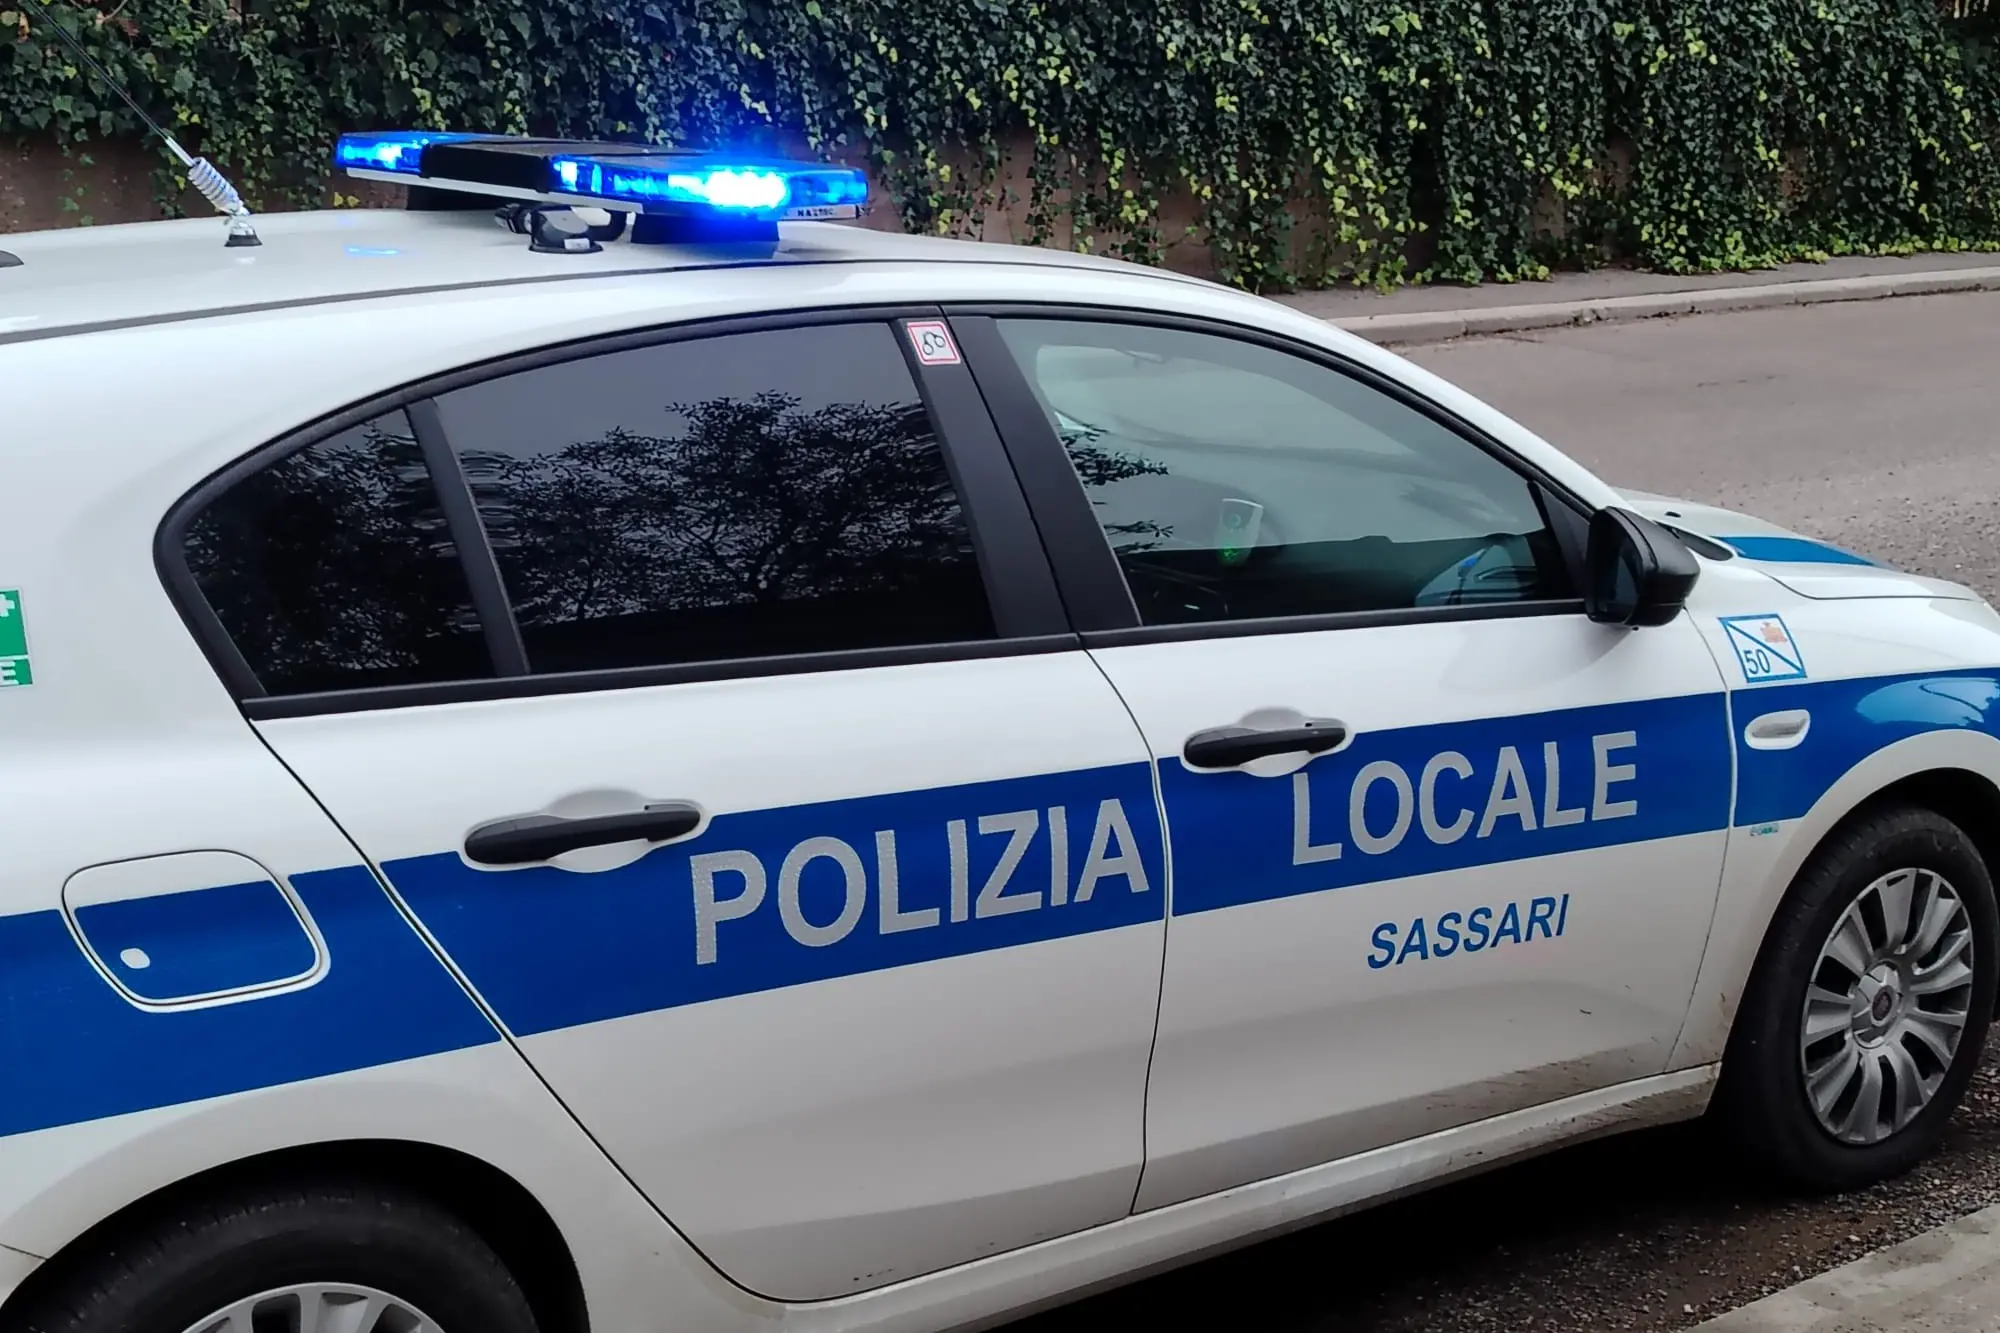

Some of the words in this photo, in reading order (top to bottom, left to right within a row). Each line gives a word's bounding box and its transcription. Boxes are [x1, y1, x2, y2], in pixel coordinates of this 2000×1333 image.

[1743, 648, 1771, 675] 50
[690, 798, 1150, 966] POLIZIA
[1293, 730, 1638, 866] LOCALE
[1367, 893, 1570, 970] SASSARI
